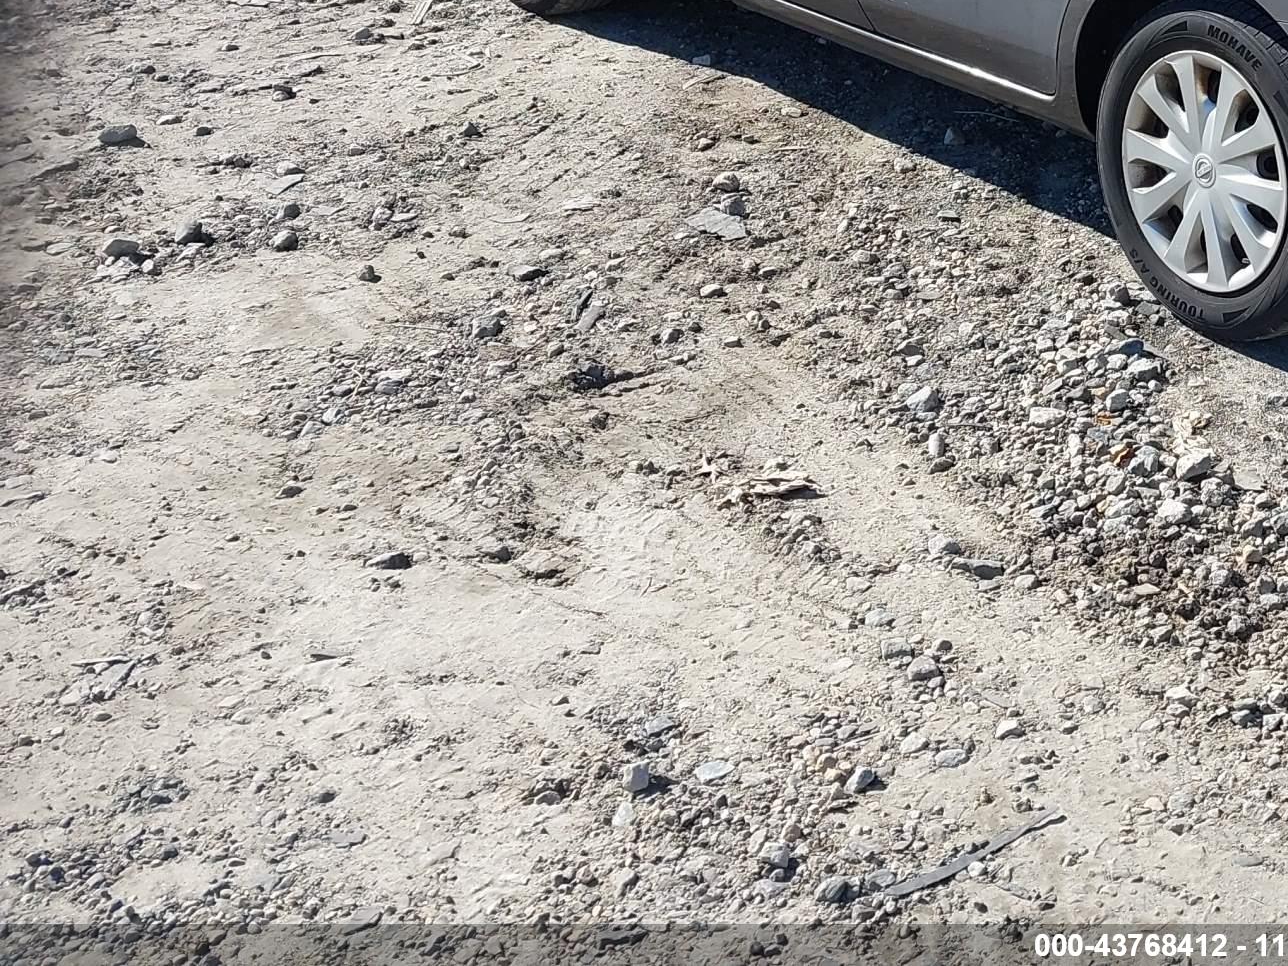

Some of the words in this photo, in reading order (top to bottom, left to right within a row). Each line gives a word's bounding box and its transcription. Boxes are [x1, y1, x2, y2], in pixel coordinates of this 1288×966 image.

[1207, 24, 1263, 71] MOHAVE
[1129, 249, 1150, 274] A/S
[1149, 276, 1207, 321] TOURING
